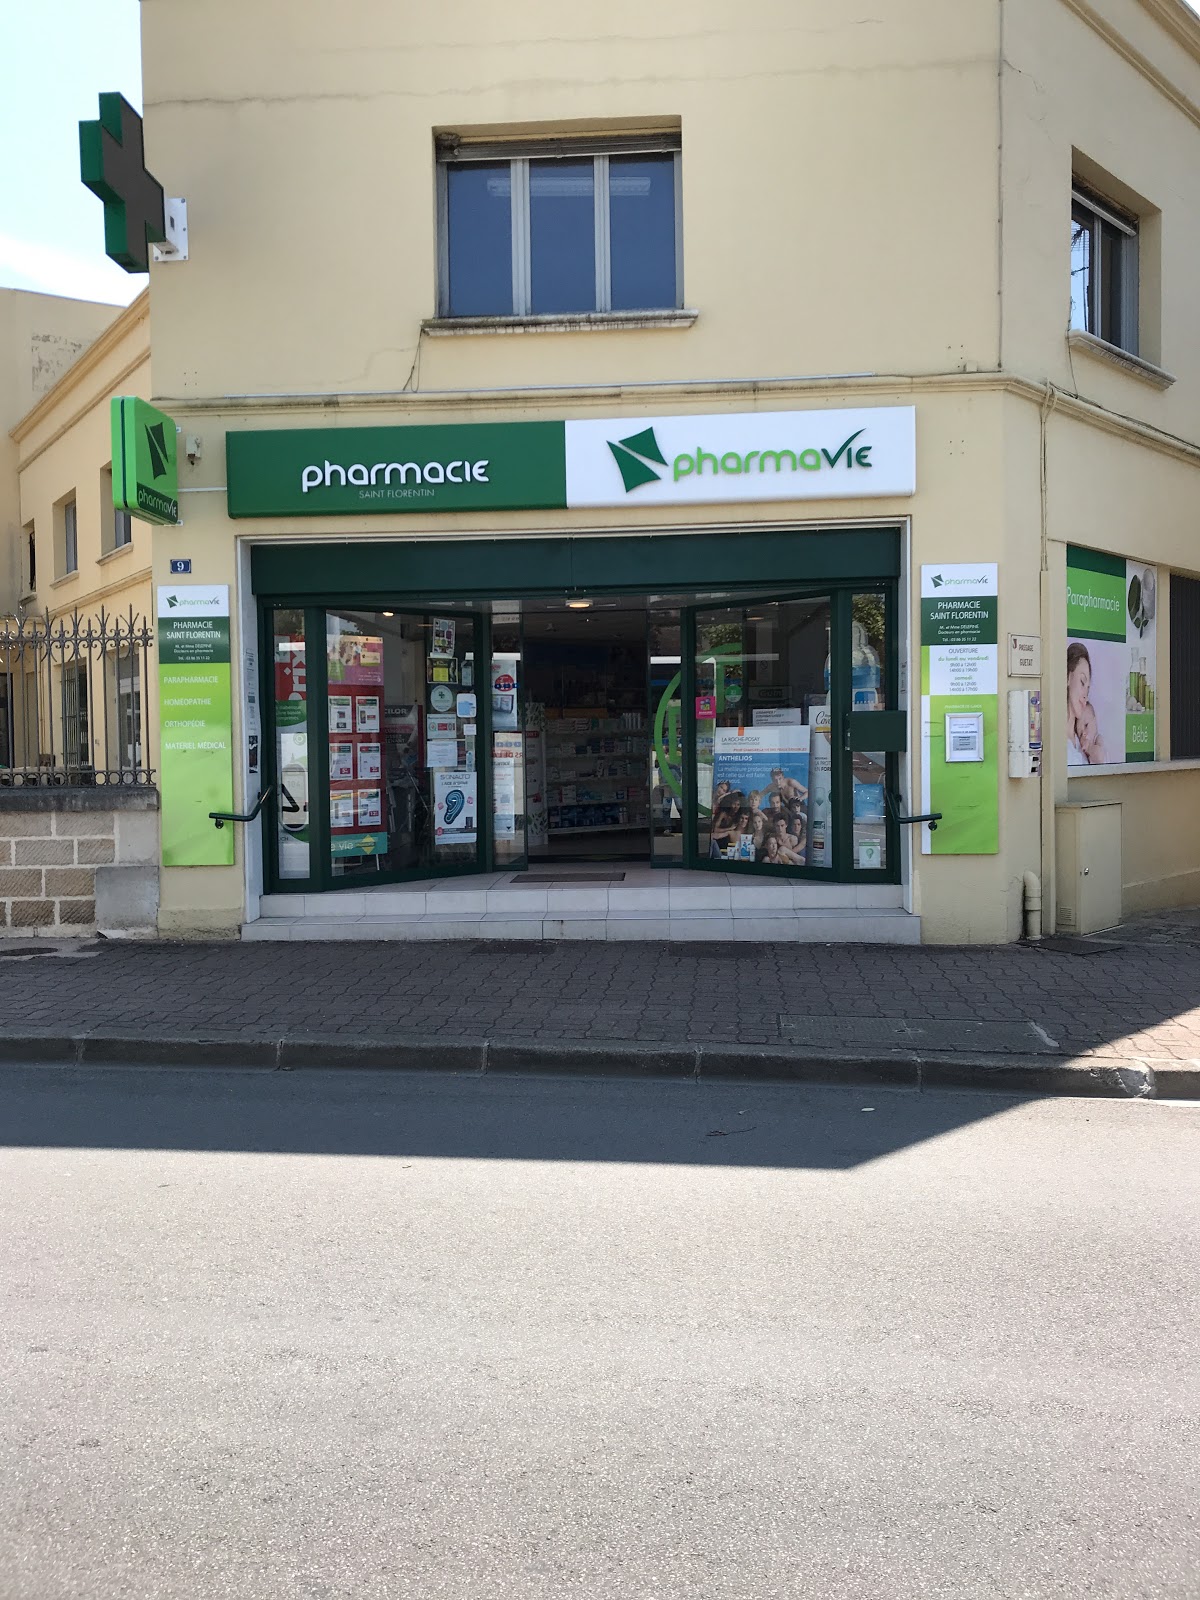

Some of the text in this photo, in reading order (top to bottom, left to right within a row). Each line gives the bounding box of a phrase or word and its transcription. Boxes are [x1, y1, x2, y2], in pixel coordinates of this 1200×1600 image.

[359, 489, 434, 499] SAINT FLORENTIN
[177, 562, 184, 571] 9
[1067, 587, 1119, 612] Parapharmacie
[938, 601, 980, 609] PHARMACIE
[930, 611, 988, 620] SAINT FLORENTIN
[174, 621, 212, 629] PHARMACIE
[1132, 726, 1148, 742] Bébé
[198, 740, 226, 749] MÉDICAL
